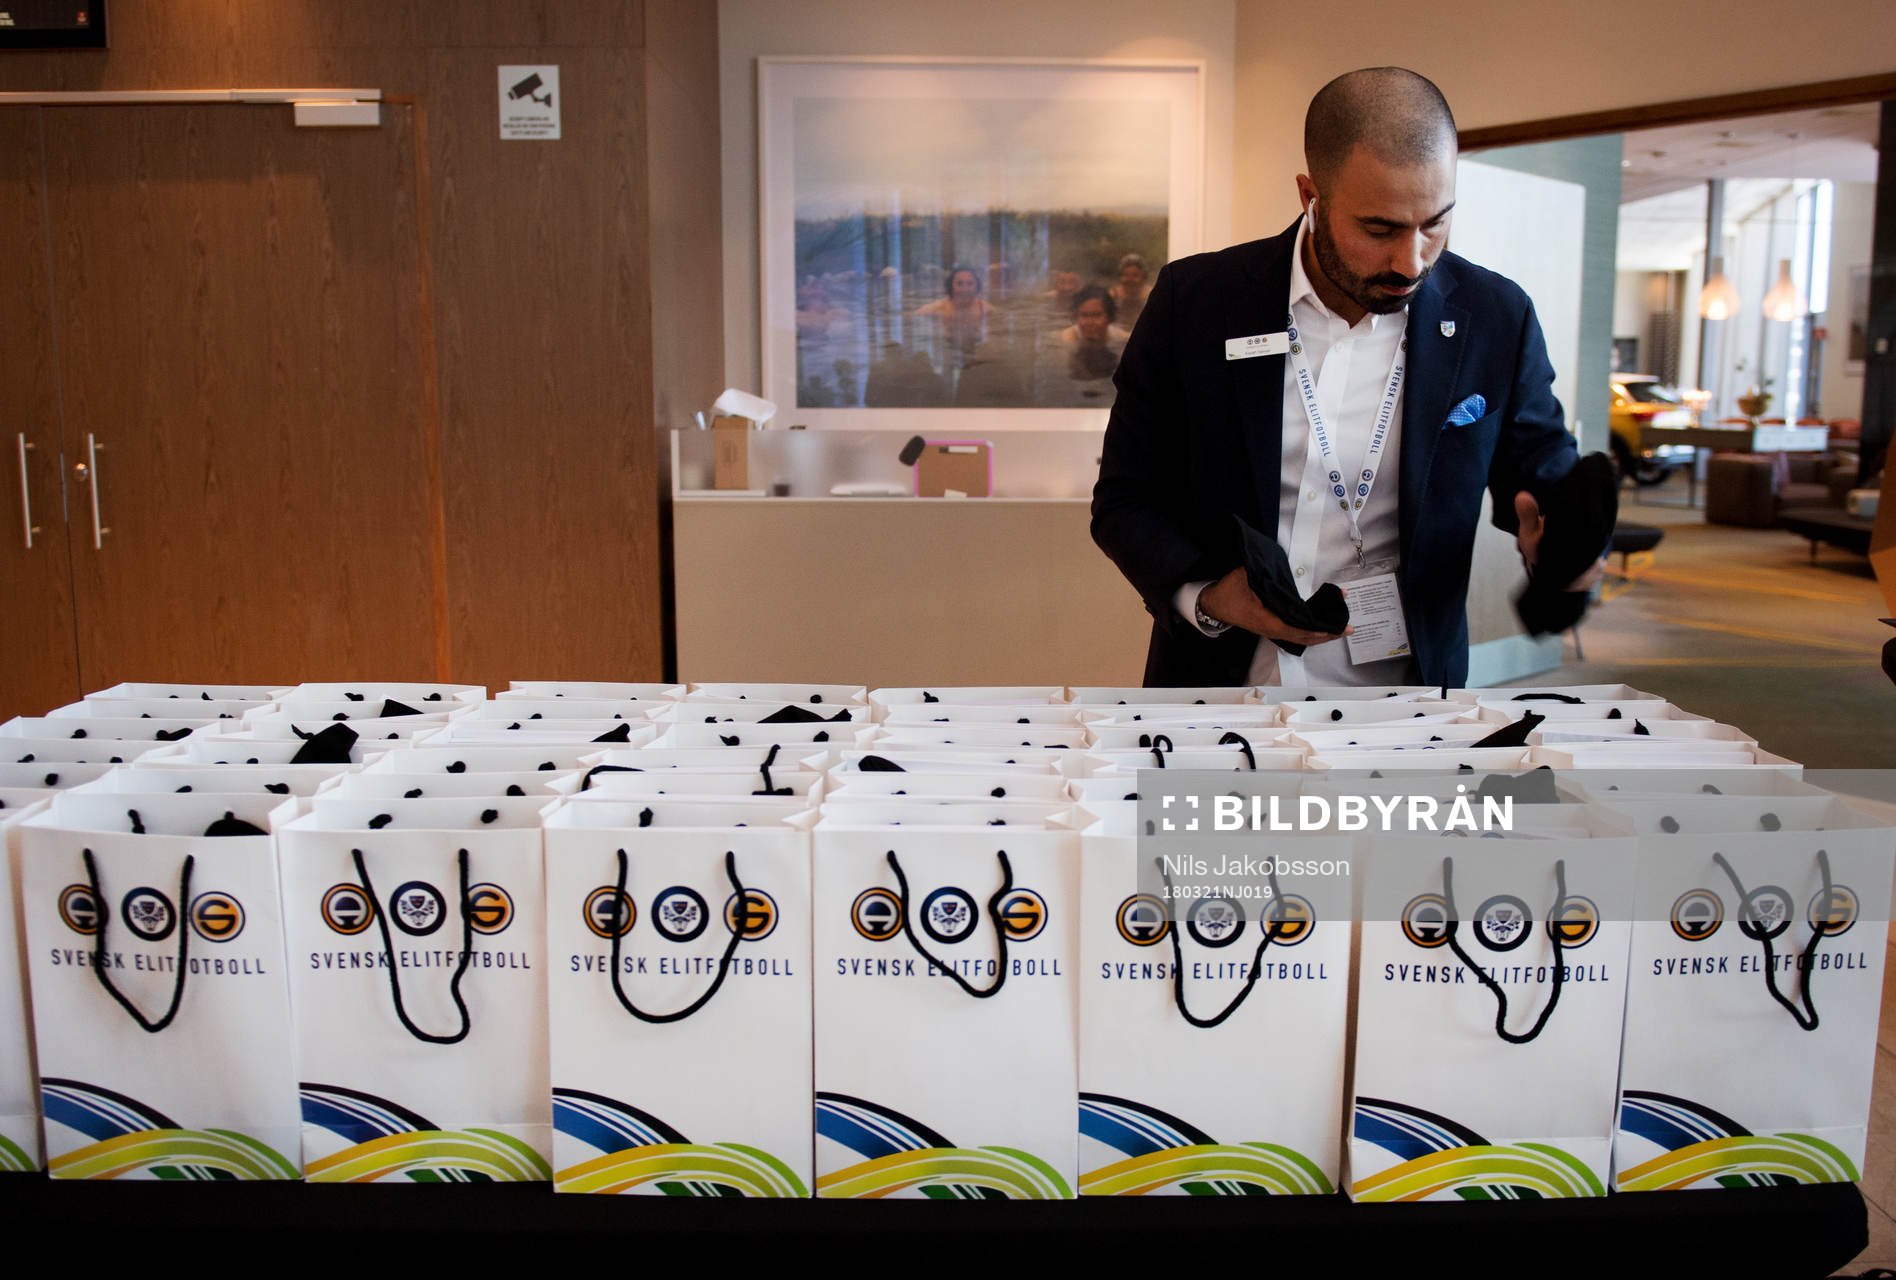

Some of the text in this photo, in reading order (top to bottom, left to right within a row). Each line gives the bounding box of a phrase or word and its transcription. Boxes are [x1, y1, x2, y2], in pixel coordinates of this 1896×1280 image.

[1299, 368, 1331, 457] SVENSK ELITFOTBOLL
[1370, 365, 1403, 454] SVENSK ELITFOTBOLL
[135, 954, 265, 975] ELITOTBOLL
[310, 952, 391, 969] SVENSK
[570, 955, 793, 976] SVESK ELITFTBOLL
[837, 958, 915, 976] SVENSK
[1653, 956, 1728, 975] SVENSK
[1193, 962, 1328, 980] ELITFTBOLL
[1384, 964, 1465, 984] SVENSK
